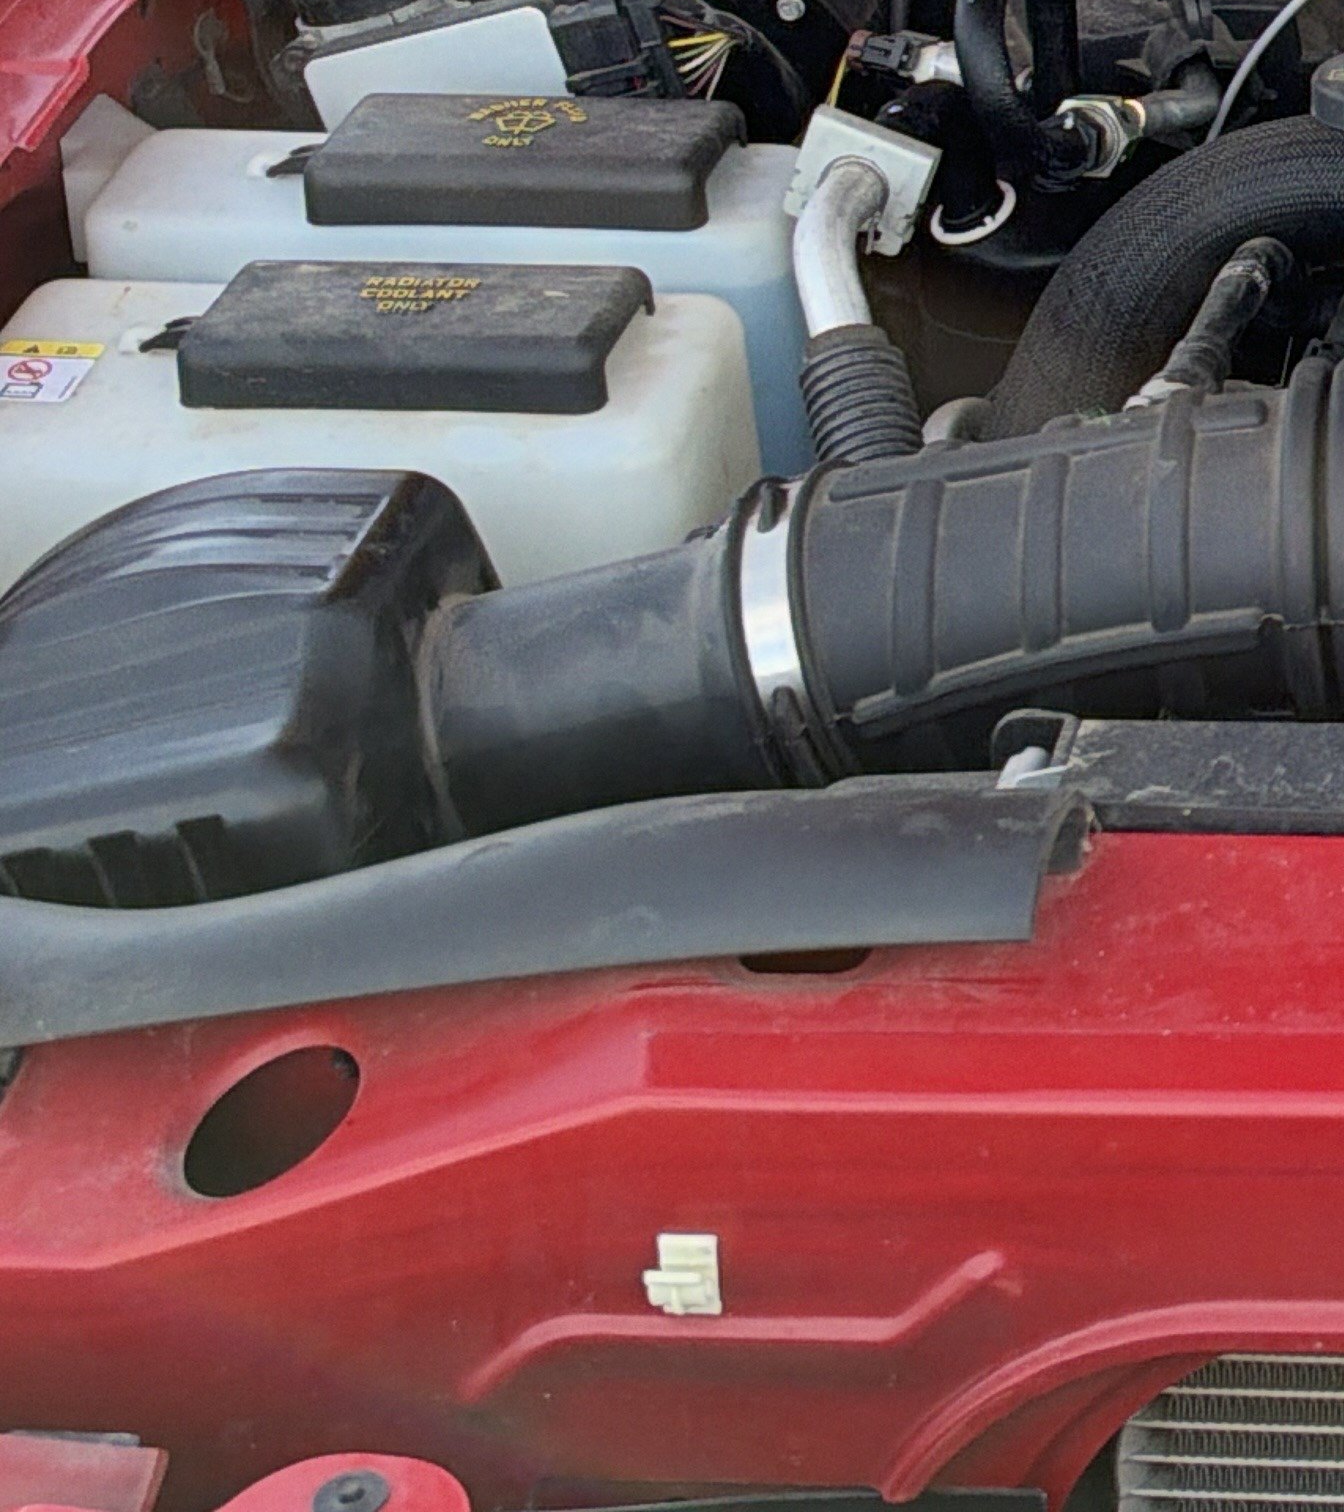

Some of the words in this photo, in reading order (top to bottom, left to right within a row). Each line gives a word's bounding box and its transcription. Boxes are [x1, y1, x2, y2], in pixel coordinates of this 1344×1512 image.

[468, 98, 548, 121] WASHER
[482, 135, 535, 147] ONLY
[365, 276, 481, 288] RADIATOR
[360, 288, 471, 299] COOLANT
[376, 300, 430, 313] ONLY
